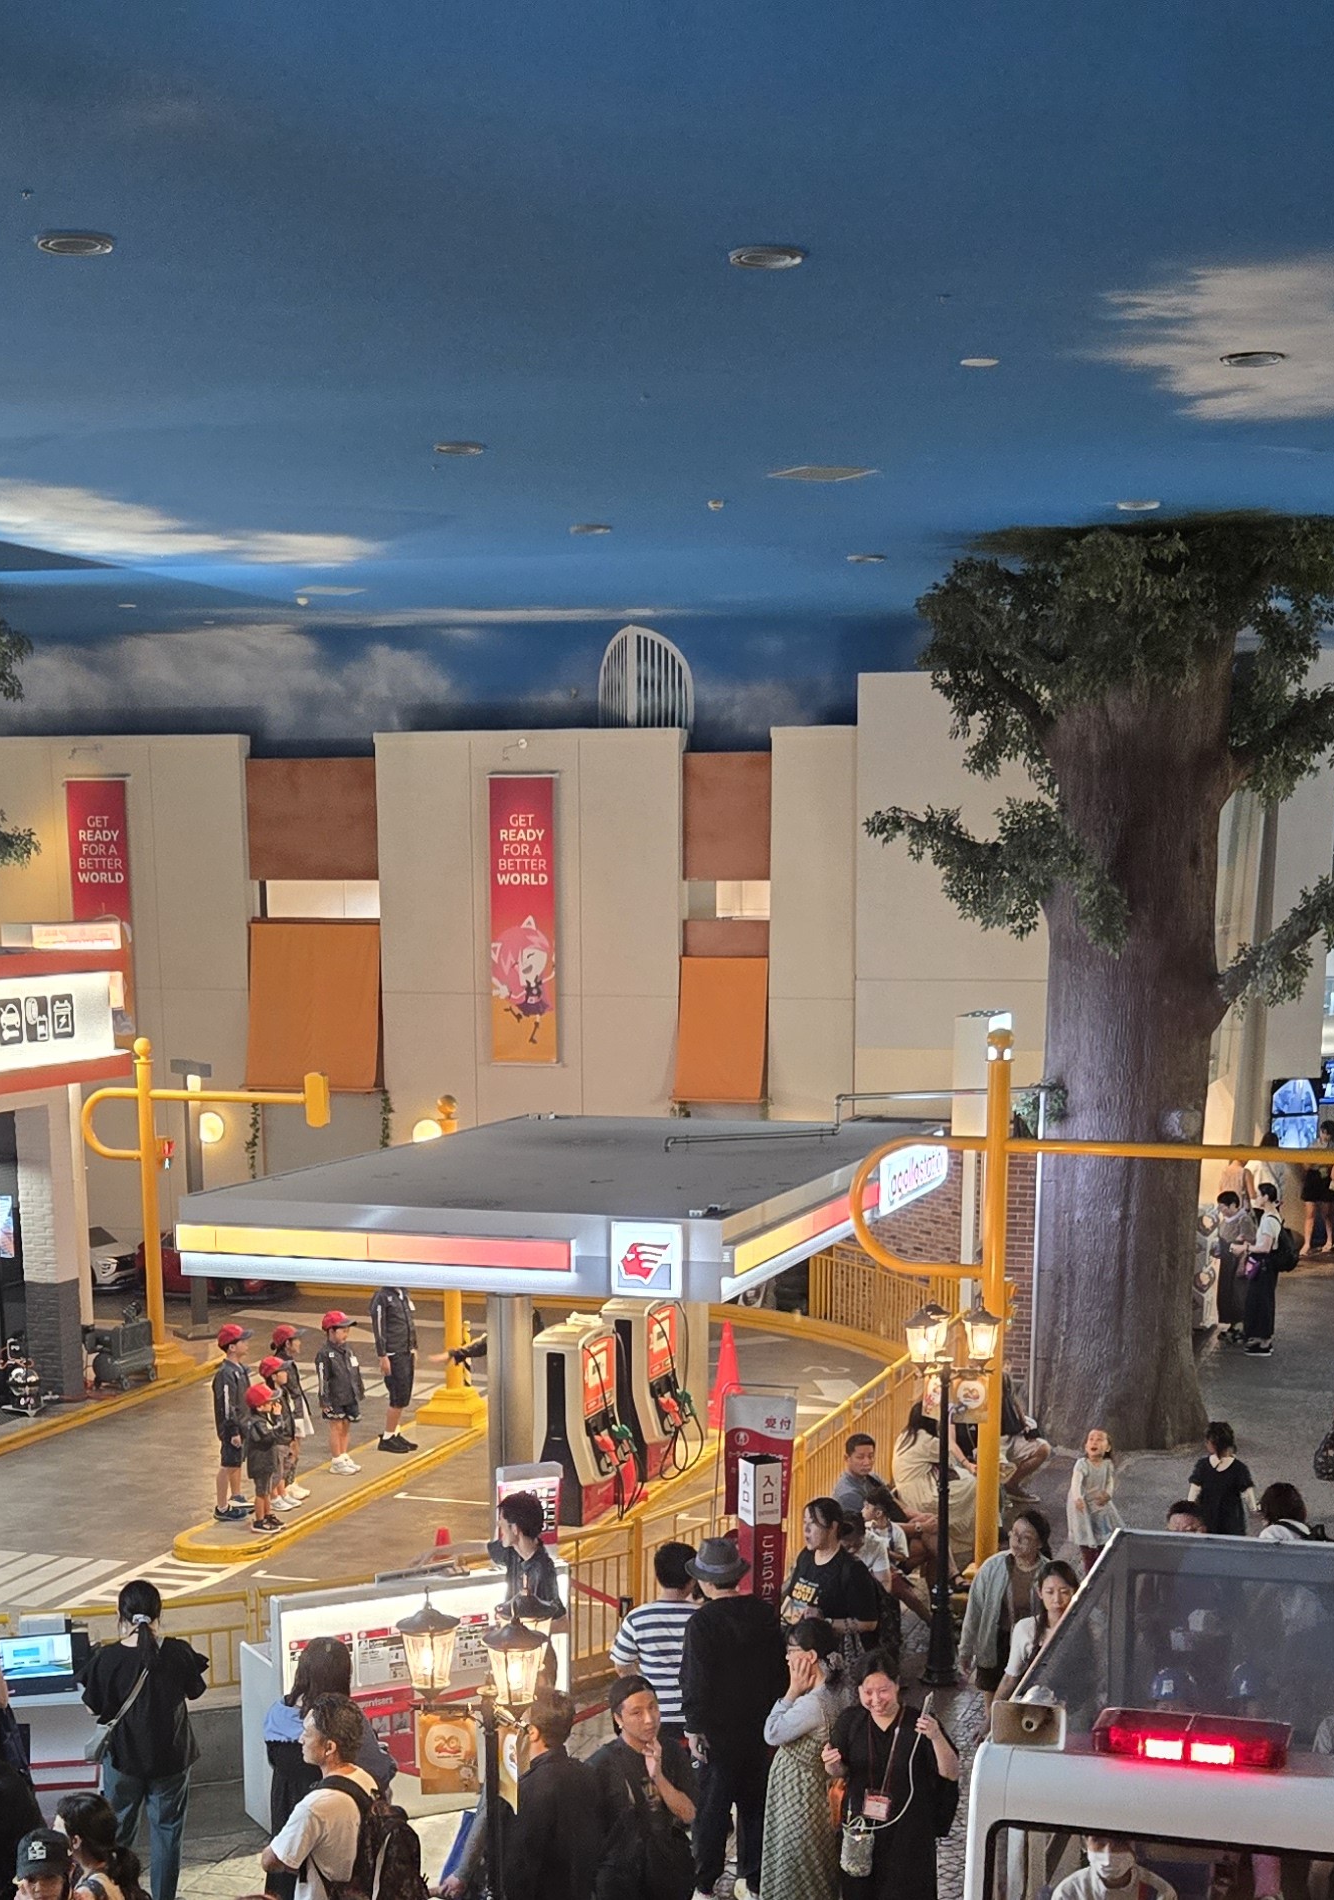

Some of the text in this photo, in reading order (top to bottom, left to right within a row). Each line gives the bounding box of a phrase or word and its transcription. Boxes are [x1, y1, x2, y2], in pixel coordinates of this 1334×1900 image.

[87, 815, 109, 828] GET
[509, 814, 535, 828] GET
[78, 830, 119, 842] READY
[499, 829, 545, 842] READY
[82, 844, 118, 856] FOR A
[503, 844, 542, 856] FOR A
[78, 858, 123, 870] BETTER
[498, 859, 547, 871] BETTER
[77, 872, 124, 884] WORLD
[497, 873, 548, 885] WORLD
[762, 1475, 775, 1505] 入口
[762, 1534, 775, 1604] こちらか
